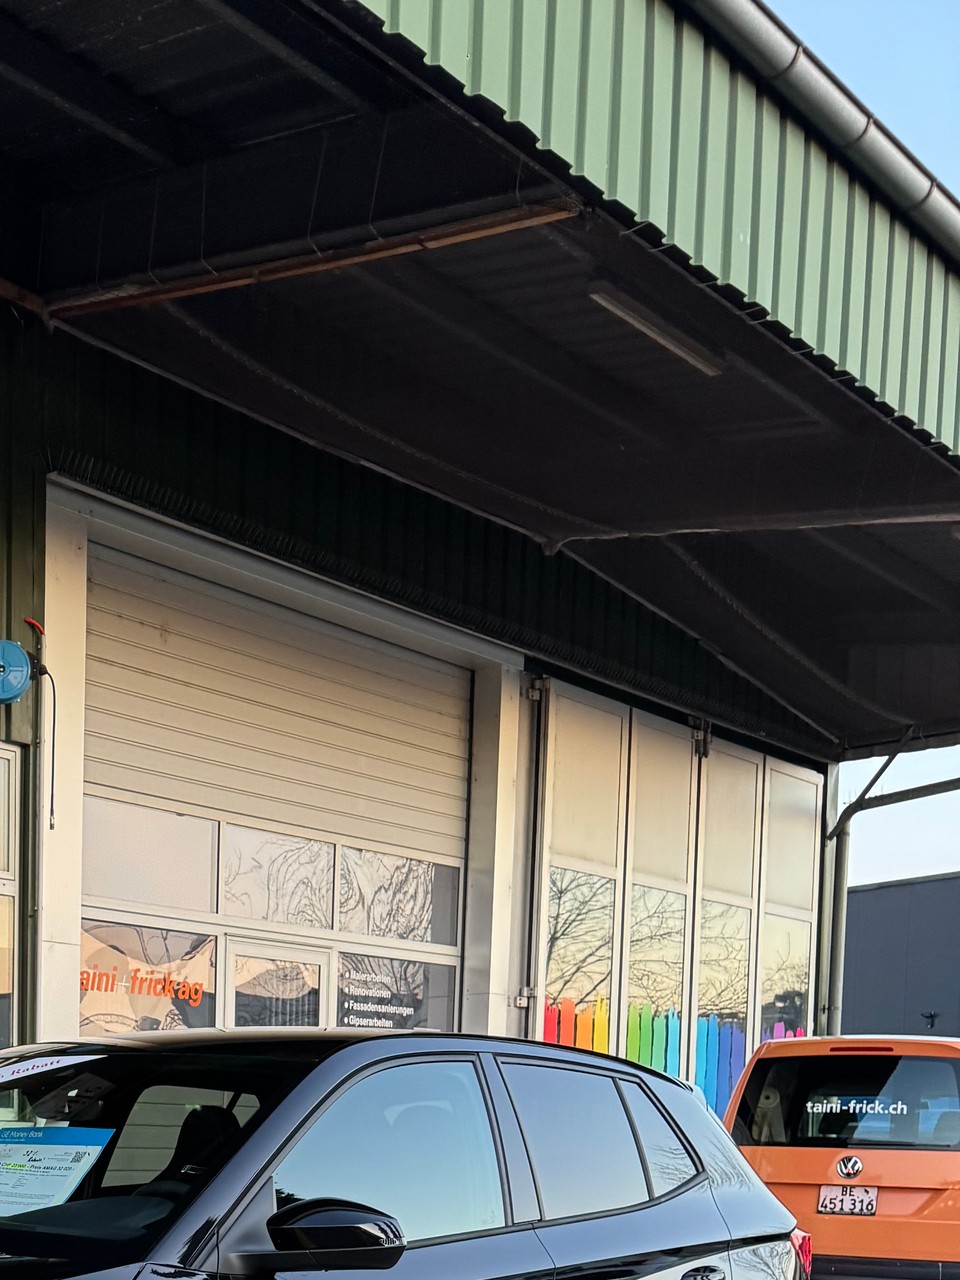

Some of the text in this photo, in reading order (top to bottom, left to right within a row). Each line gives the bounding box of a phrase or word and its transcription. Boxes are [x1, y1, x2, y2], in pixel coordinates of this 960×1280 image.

[349, 985, 392, 998] Renovationen
[349, 1000, 414, 1017] Fassadensanierungen
[349, 1015, 393, 1028] Gipserarbeiten
[10, 1059, 62, 1076] Rabatt
[806, 1100, 908, 1115] taini-frick.ch
[841, 1186, 856, 1197] BE
